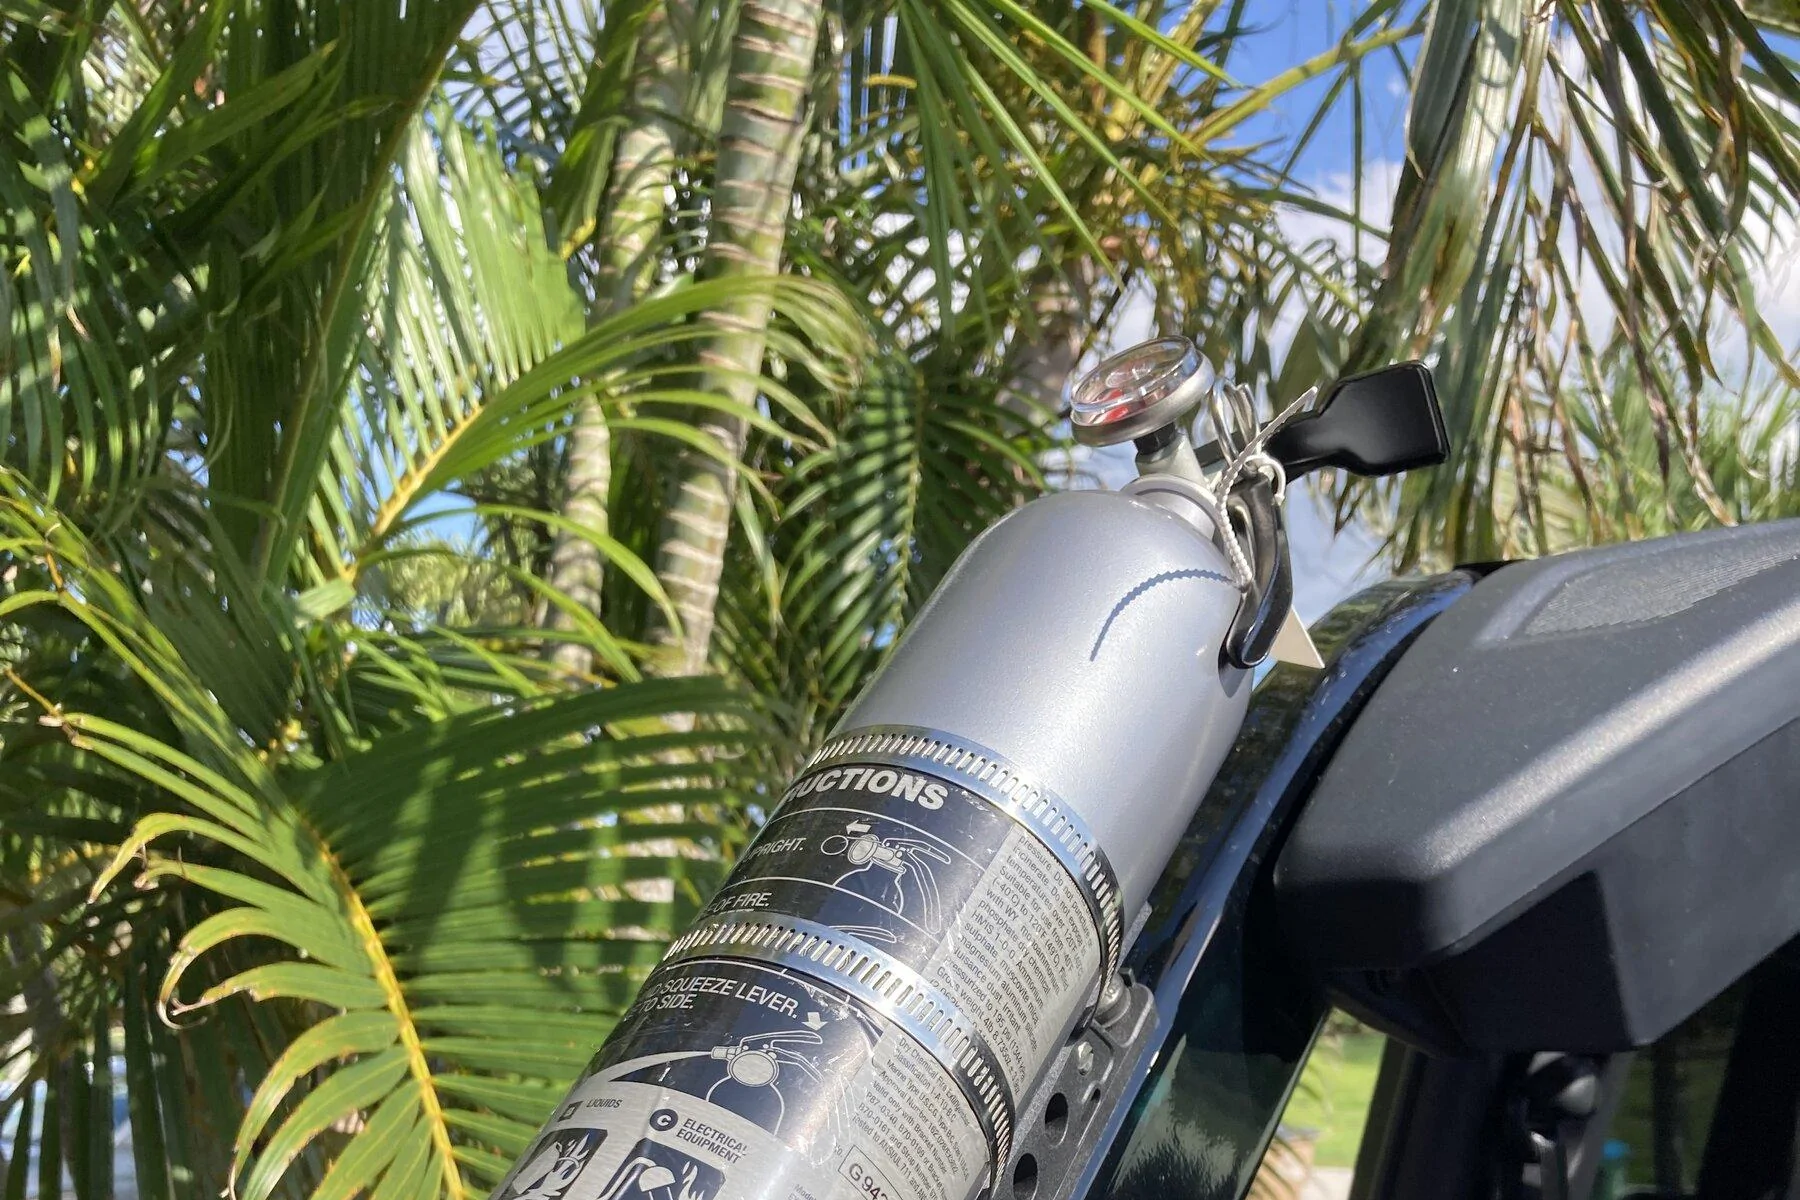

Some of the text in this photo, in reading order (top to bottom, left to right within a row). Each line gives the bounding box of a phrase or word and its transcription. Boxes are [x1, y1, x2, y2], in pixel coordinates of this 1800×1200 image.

[735, 892, 772, 908] FIRE.
[985, 888, 1004, 908] with
[999, 866, 1031, 900] Suitable
[1030, 897, 1041, 913] for
[1040, 911, 1052, 929] use
[1051, 927, 1064, 950] from
[1005, 855, 1052, 911] temperatures
[1051, 910, 1064, 929] over
[1020, 904, 1028, 916] to
[1050, 886, 1061, 902] Do
[1059, 901, 1069, 916] not
[1053, 870, 1064, 887] Do
[1062, 886, 1074, 902] not
[1071, 900, 1090, 939] puncture
[978, 899, 1018, 943] phosphate
[1018, 940, 1028, 959] dry
[971, 911, 994, 934] HMIS
[1016, 959, 1043, 1009] Ammonium
[657, 993, 697, 1010] SIDE.
[661, 976, 738, 996] SQUEEZE
[735, 982, 798, 1019] LEVER.
[999, 959, 1029, 1004] muscovite
[1000, 979, 1026, 1023] aluminum
[960, 988, 984, 1021] weight
[985, 999, 993, 1011] to
[992, 1008, 1004, 1028] 195
[1002, 1027, 1011, 1042] psi
[899, 1038, 911, 1053] Dry
[911, 1049, 937, 1079] Chemical
[586, 1099, 623, 1109] LIQUIDS
[879, 1069, 906, 1099] Approval
[906, 1096, 928, 1124] Number
[906, 1079, 919, 1096] Type
[887, 1096, 901, 1112] only
[901, 1109, 914, 1126] with
[676, 1128, 742, 1164] EQUIPMENT
[872, 1132, 880, 1142] to
[900, 1163, 911, 1179] 711
[901, 1145, 915, 1166] Strap
